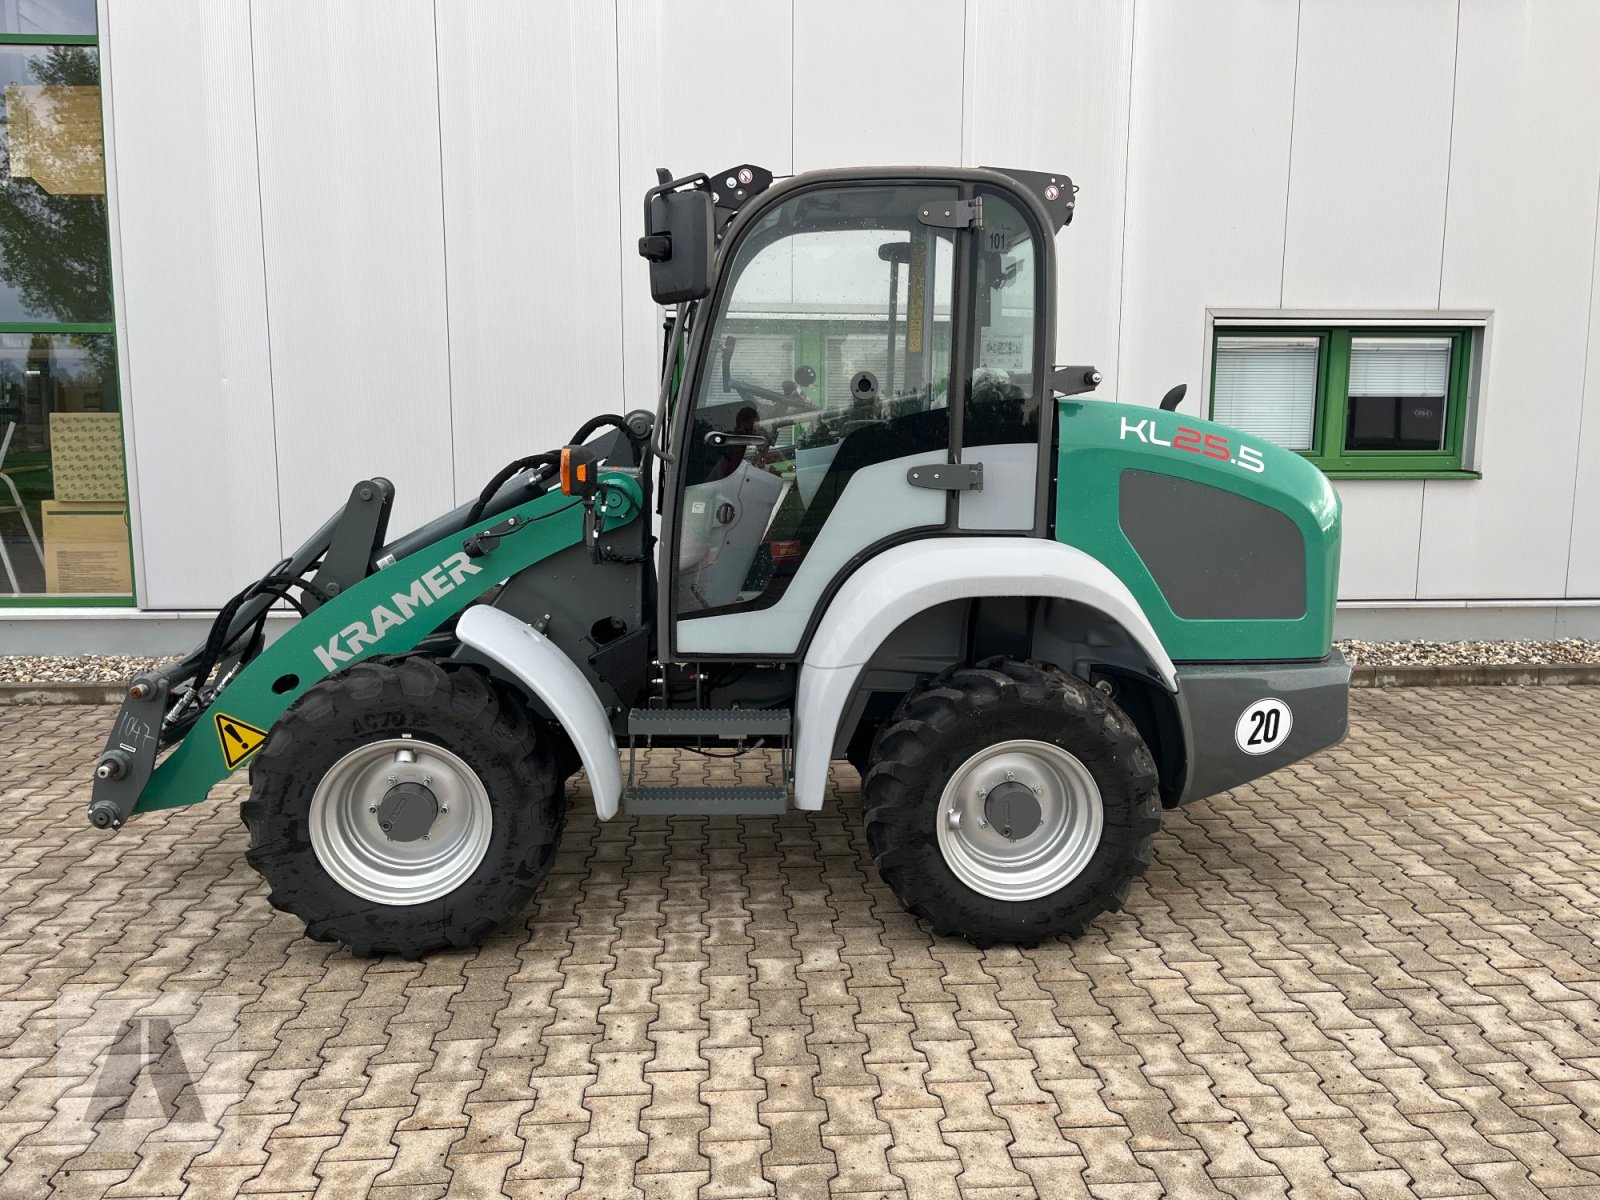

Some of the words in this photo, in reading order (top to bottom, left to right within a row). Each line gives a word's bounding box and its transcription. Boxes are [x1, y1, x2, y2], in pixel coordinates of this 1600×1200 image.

[990, 233, 1005, 249] 101
[1120, 416, 1265, 473] KL25.5
[313, 551, 483, 672] KRAMER
[1247, 708, 1280, 745] 20
